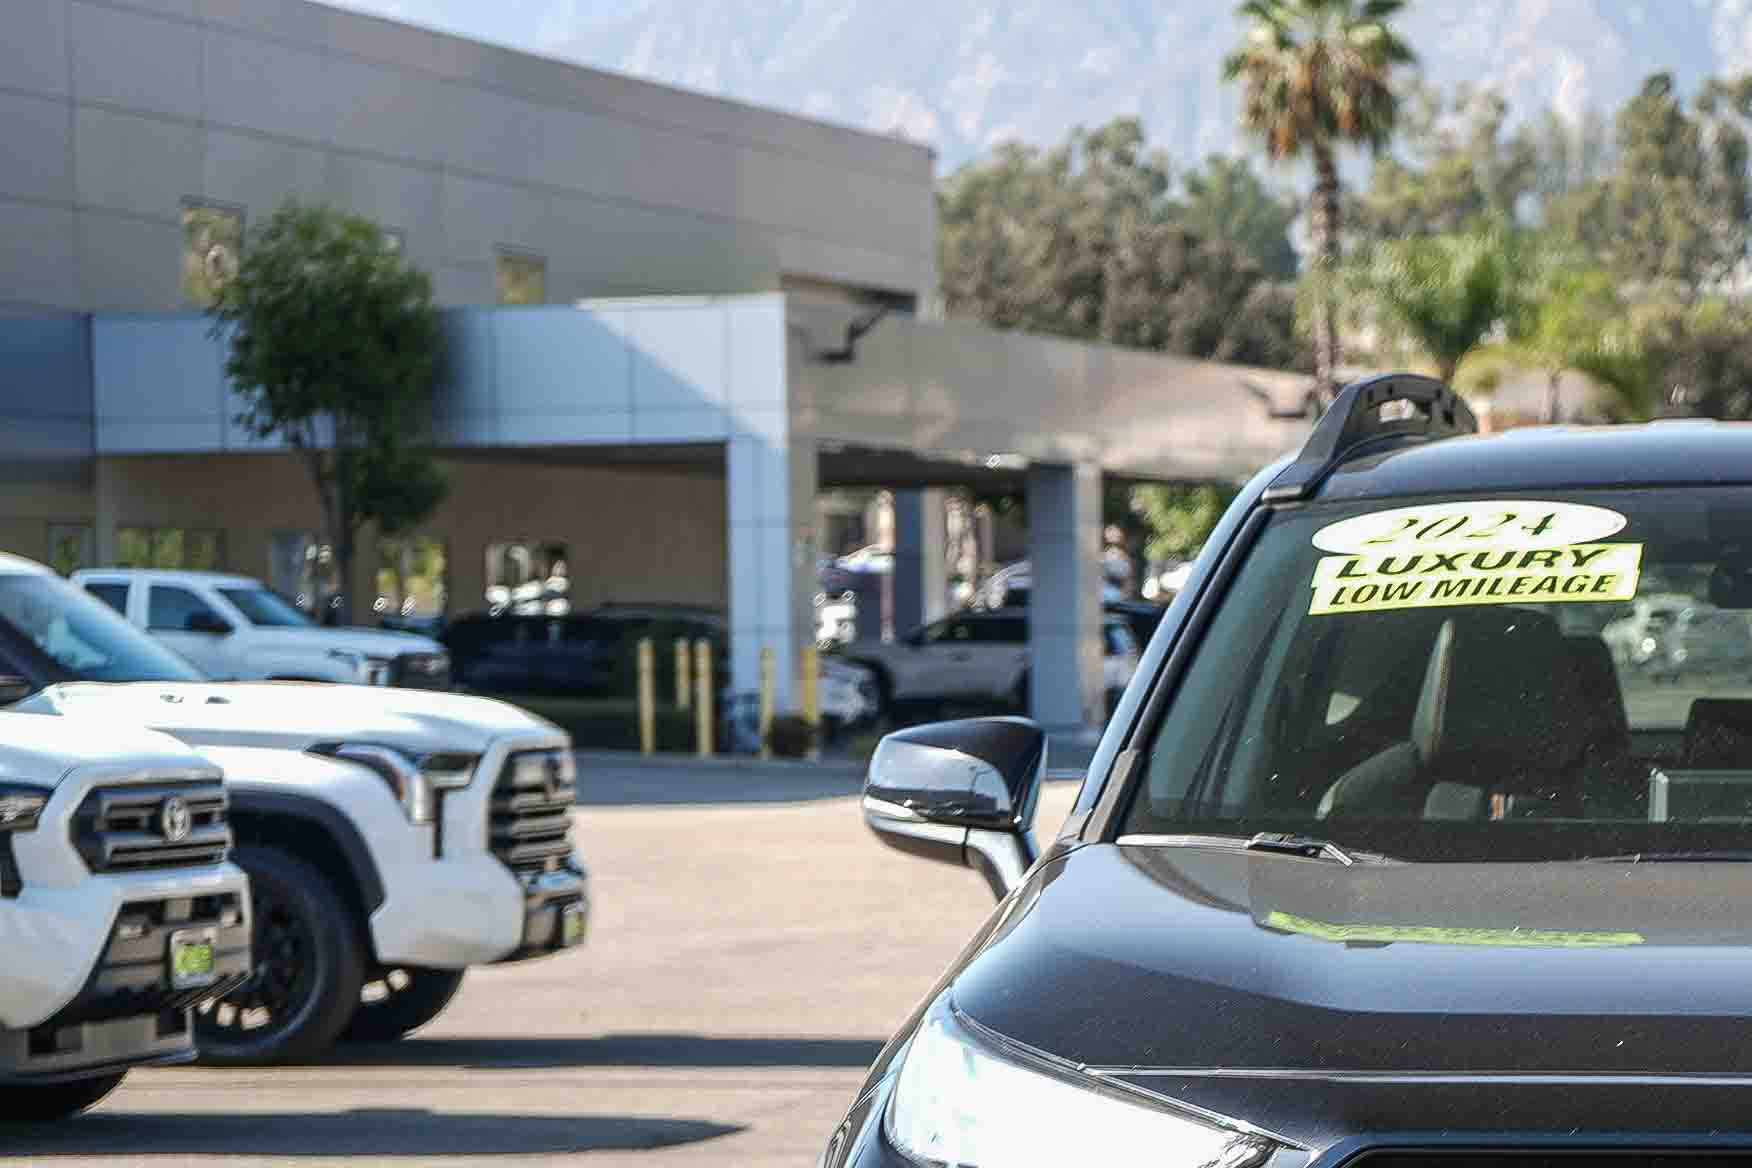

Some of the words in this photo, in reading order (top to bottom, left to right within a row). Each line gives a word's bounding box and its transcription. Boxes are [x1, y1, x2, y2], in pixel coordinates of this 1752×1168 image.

[1365, 511, 1560, 545] 2024
[1336, 549, 1607, 579] LUXURY
[1329, 581, 1419, 606] LOW
[1429, 574, 1617, 599] MILEAGE
